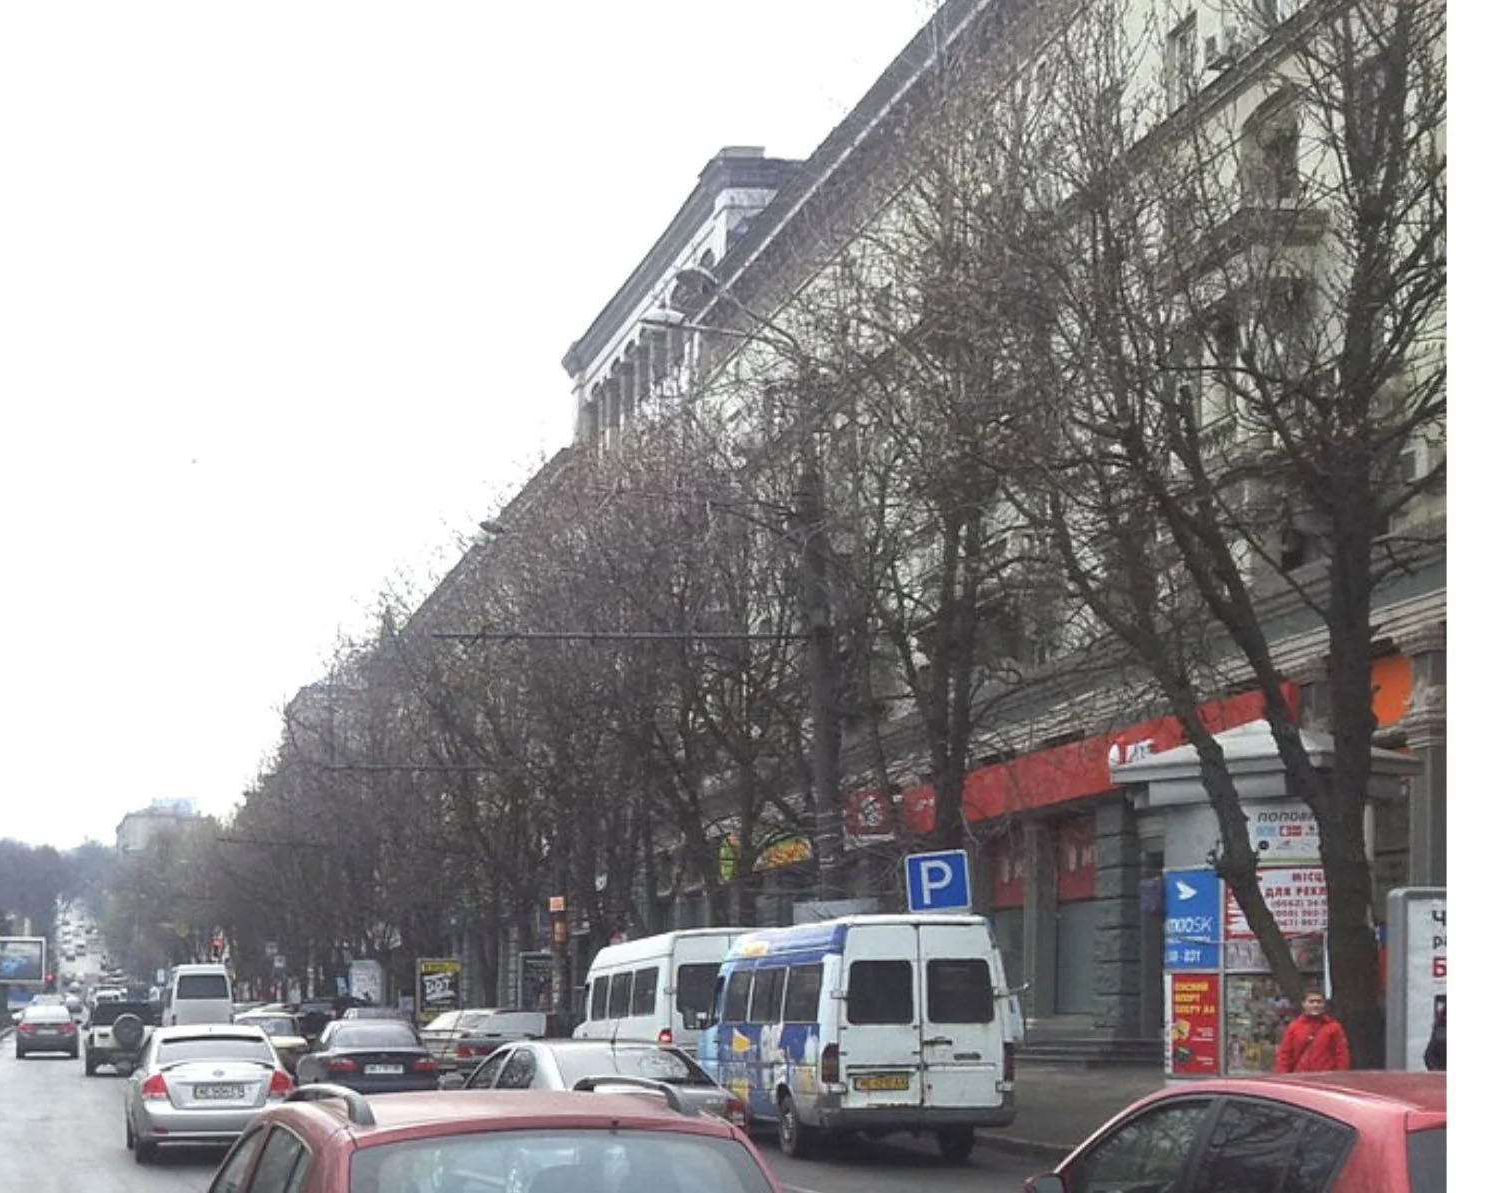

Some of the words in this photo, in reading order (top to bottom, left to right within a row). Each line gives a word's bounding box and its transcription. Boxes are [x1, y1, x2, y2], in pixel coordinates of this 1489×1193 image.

[920, 861, 953, 904] P
[1265, 887, 1291, 898] ДЛЯ
[1432, 935, 1447, 950] р
